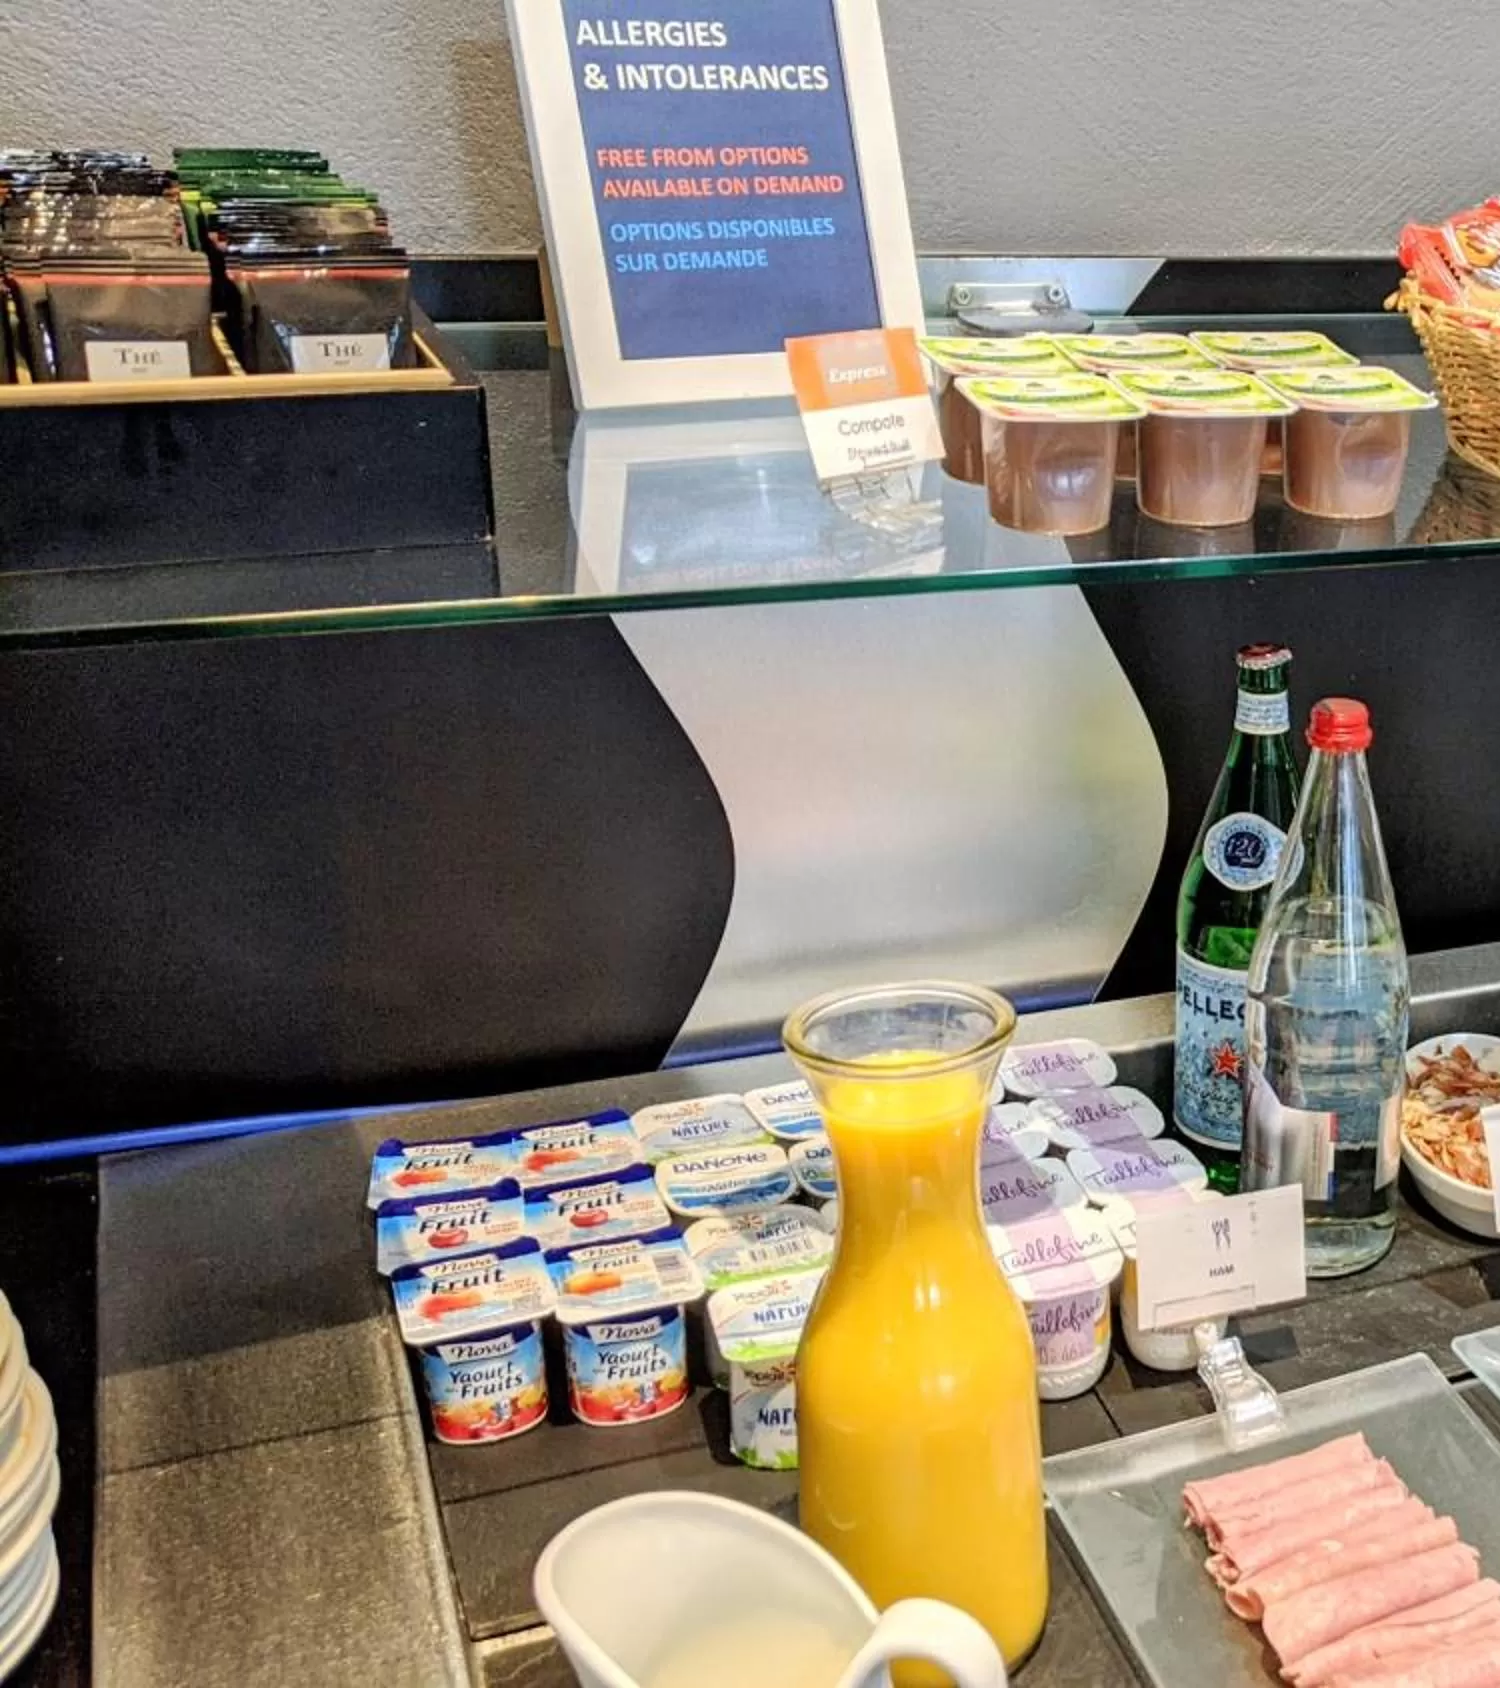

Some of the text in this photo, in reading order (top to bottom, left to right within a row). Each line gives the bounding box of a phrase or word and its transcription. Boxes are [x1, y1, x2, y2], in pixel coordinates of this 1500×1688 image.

[577, 19, 727, 47] ALLERGIES
[584, 63, 830, 91] & INTOLERANCES
[597, 146, 809, 167] FREE FROM OPTIONS
[603, 175, 844, 199] AVAILABLE ON DEMAND
[610, 217, 836, 243] OPTIONS DISPONIBLES
[615, 248, 769, 273] SUR DEMANDE
[828, 365, 889, 384] Express
[837, 414, 905, 436] Compote
[672, 1119, 733, 1138] NATURE
[533, 1133, 598, 1152] Fruit
[404, 1151, 474, 1171] Fruit
[673, 1152, 769, 1174] DANONE
[1085, 1153, 1186, 1186] Taillefine
[983, 1172, 1064, 1205] aillefine
[558, 1191, 625, 1217] Fruit
[420, 1210, 492, 1233] Fruit
[592, 1254, 641, 1271] Fruit
[1209, 1264, 1235, 1277] HAM
[432, 1269, 507, 1294] Fruit
[753, 1303, 808, 1324] NATU
[599, 1322, 658, 1340] Nova
[450, 1340, 511, 1358] Nova
[598, 1344, 660, 1365] Yaourt
[449, 1361, 514, 1385] Yaourt
[606, 1356, 668, 1380] Fruits
[460, 1374, 524, 1399] Fruits
[758, 1407, 793, 1426] NAT
